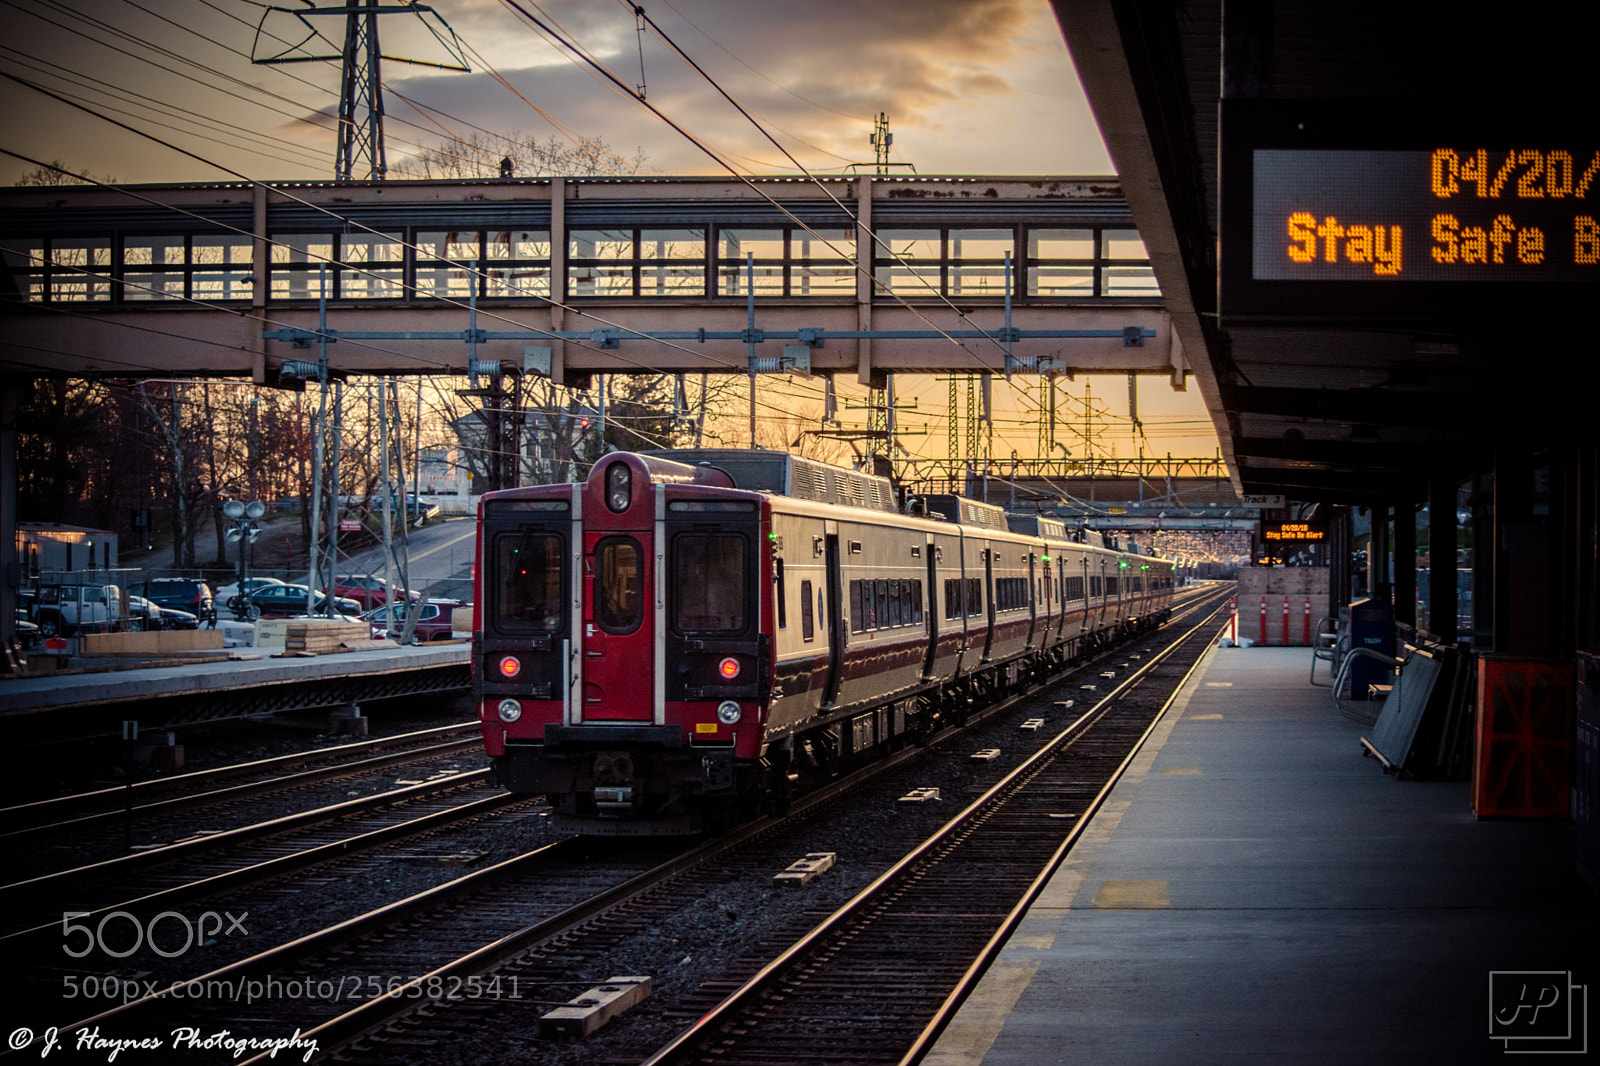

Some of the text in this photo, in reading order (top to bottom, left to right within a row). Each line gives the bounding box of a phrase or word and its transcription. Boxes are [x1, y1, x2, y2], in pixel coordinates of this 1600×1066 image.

[1288, 212, 1402, 275] Stay
[1431, 214, 1545, 264] Safe
[1243, 495, 1281, 504] Track 3
[1266, 531, 1323, 540] Stay Safe Be Alert
